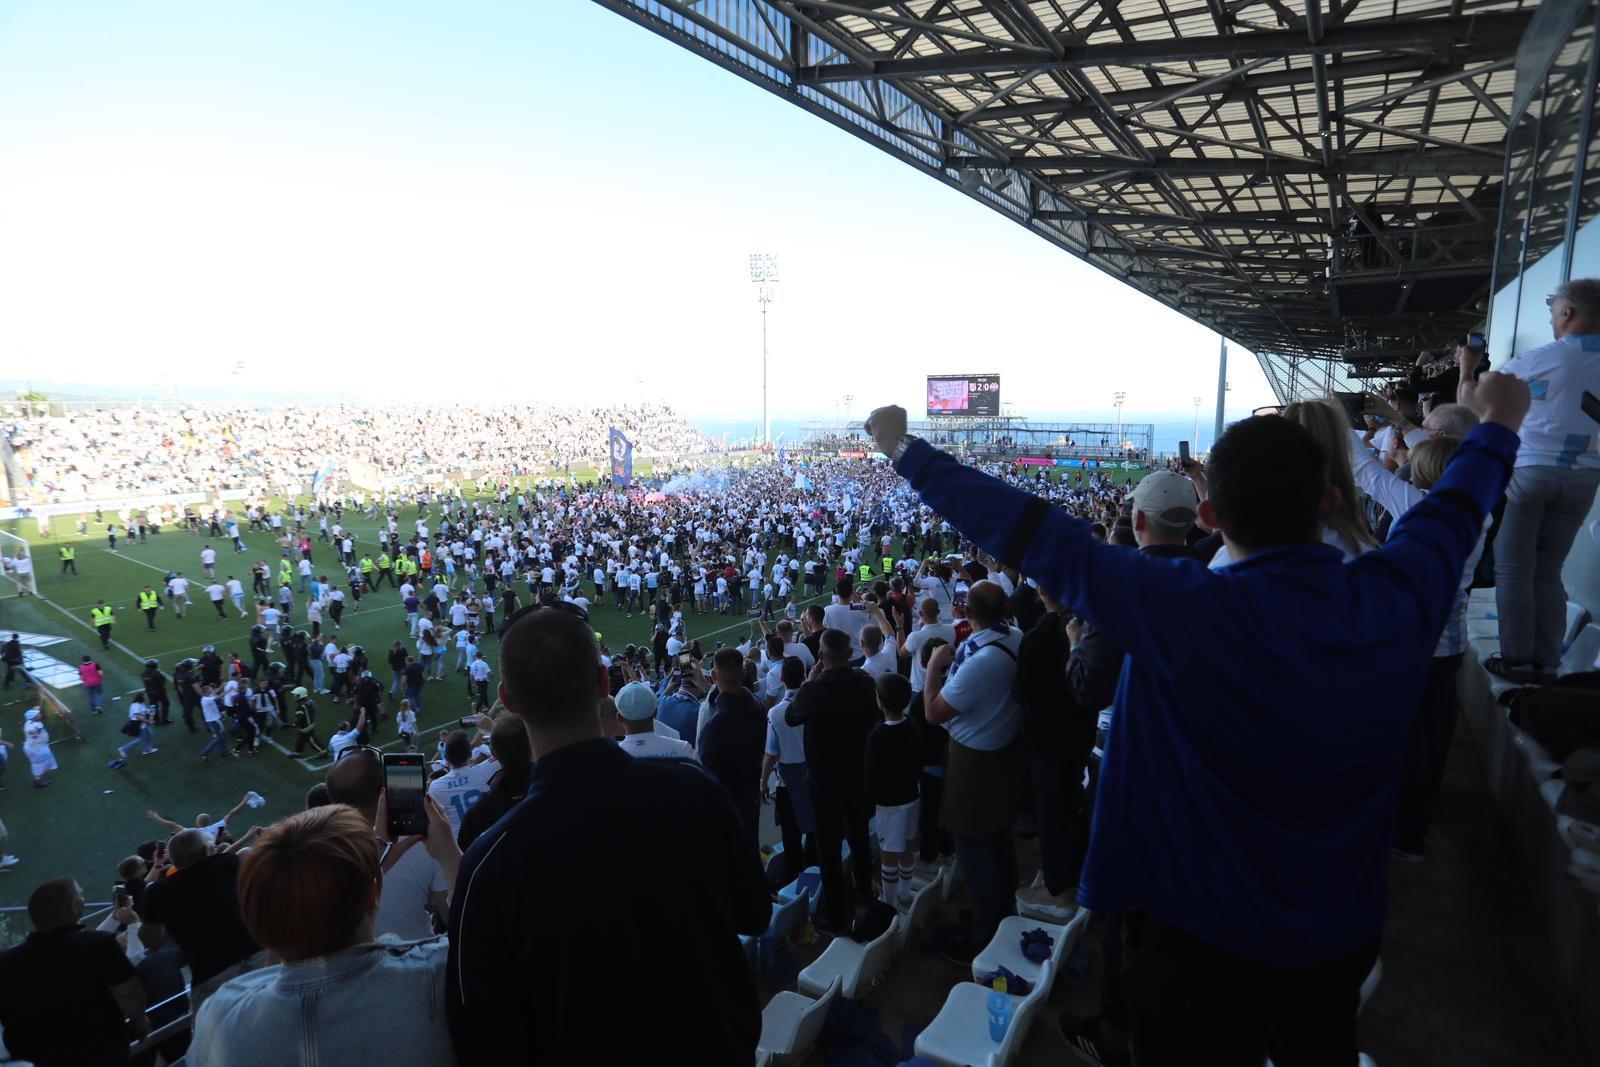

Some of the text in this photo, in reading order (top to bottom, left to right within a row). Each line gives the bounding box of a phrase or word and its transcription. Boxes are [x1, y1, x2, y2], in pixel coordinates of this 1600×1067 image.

[977, 383, 989, 391] 2 0
[474, 665, 479, 674] 9
